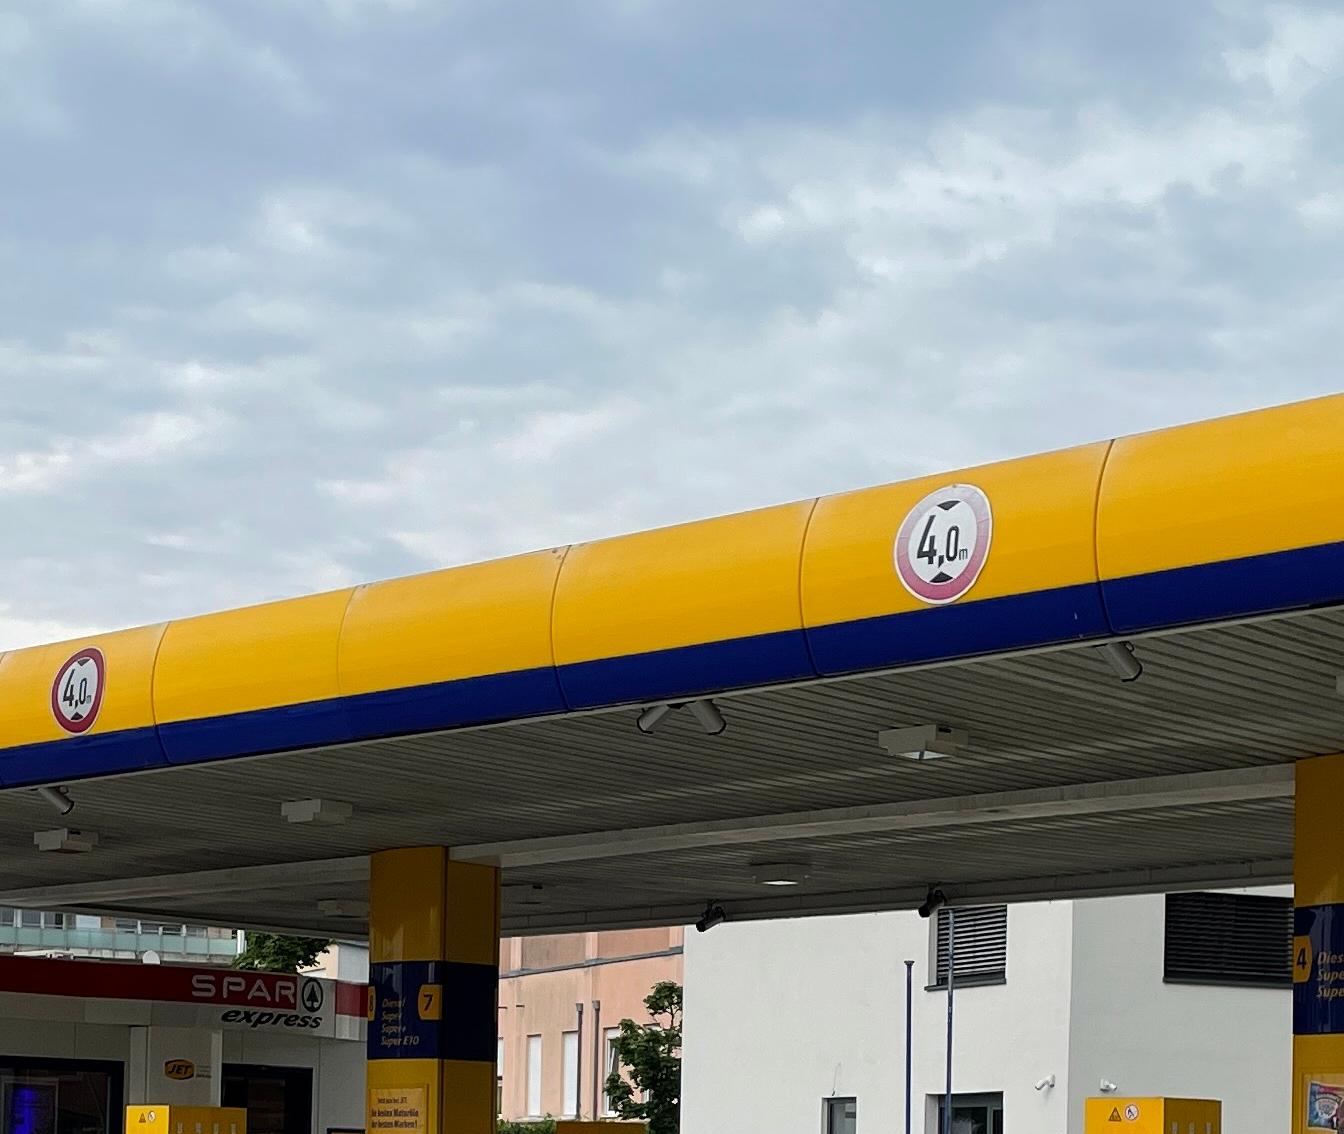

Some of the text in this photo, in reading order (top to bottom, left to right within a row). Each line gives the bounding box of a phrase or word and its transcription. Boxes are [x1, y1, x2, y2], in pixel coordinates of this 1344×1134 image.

[1296, 948, 1306, 970] 4
[191, 974, 296, 1004] SPAR
[423, 993, 433, 1012] 7
[221, 1009, 323, 1029] express
[381, 1035, 420, 1048] Super E10
[167, 1064, 193, 1075] JET
